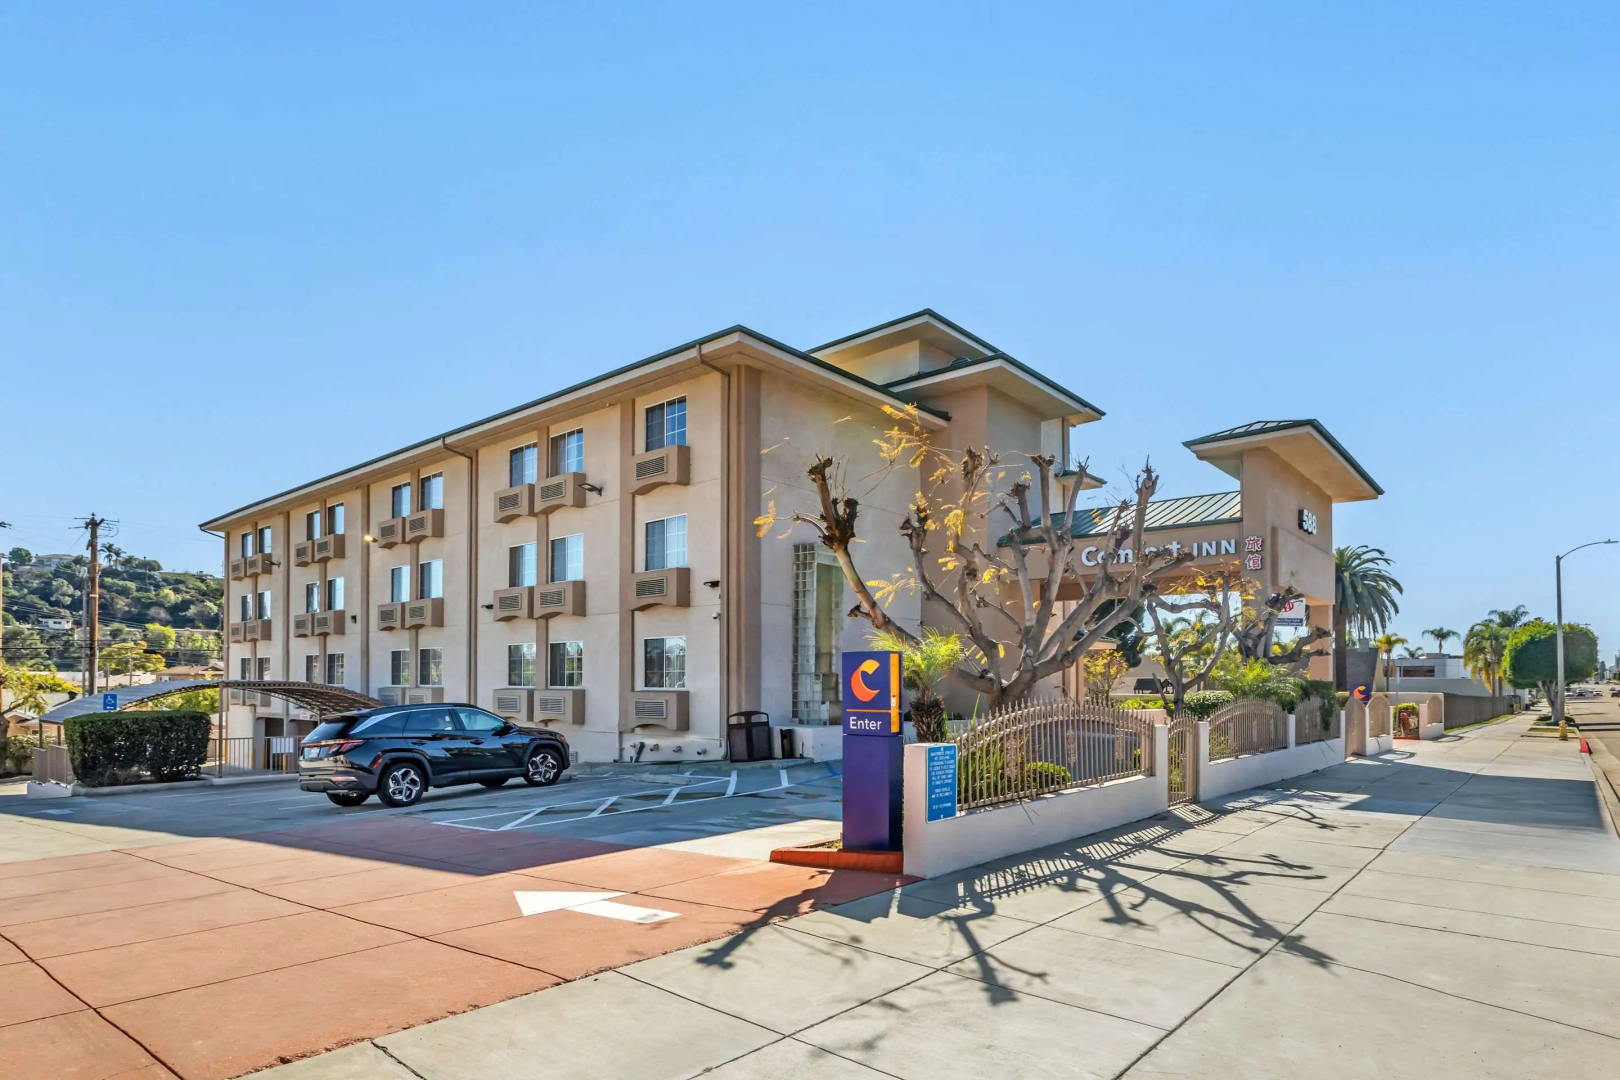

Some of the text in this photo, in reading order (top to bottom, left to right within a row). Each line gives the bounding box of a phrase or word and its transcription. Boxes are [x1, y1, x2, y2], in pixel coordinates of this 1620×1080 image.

[1081, 539, 1236, 567] Comt INN
[850, 716, 882, 731] Enter
